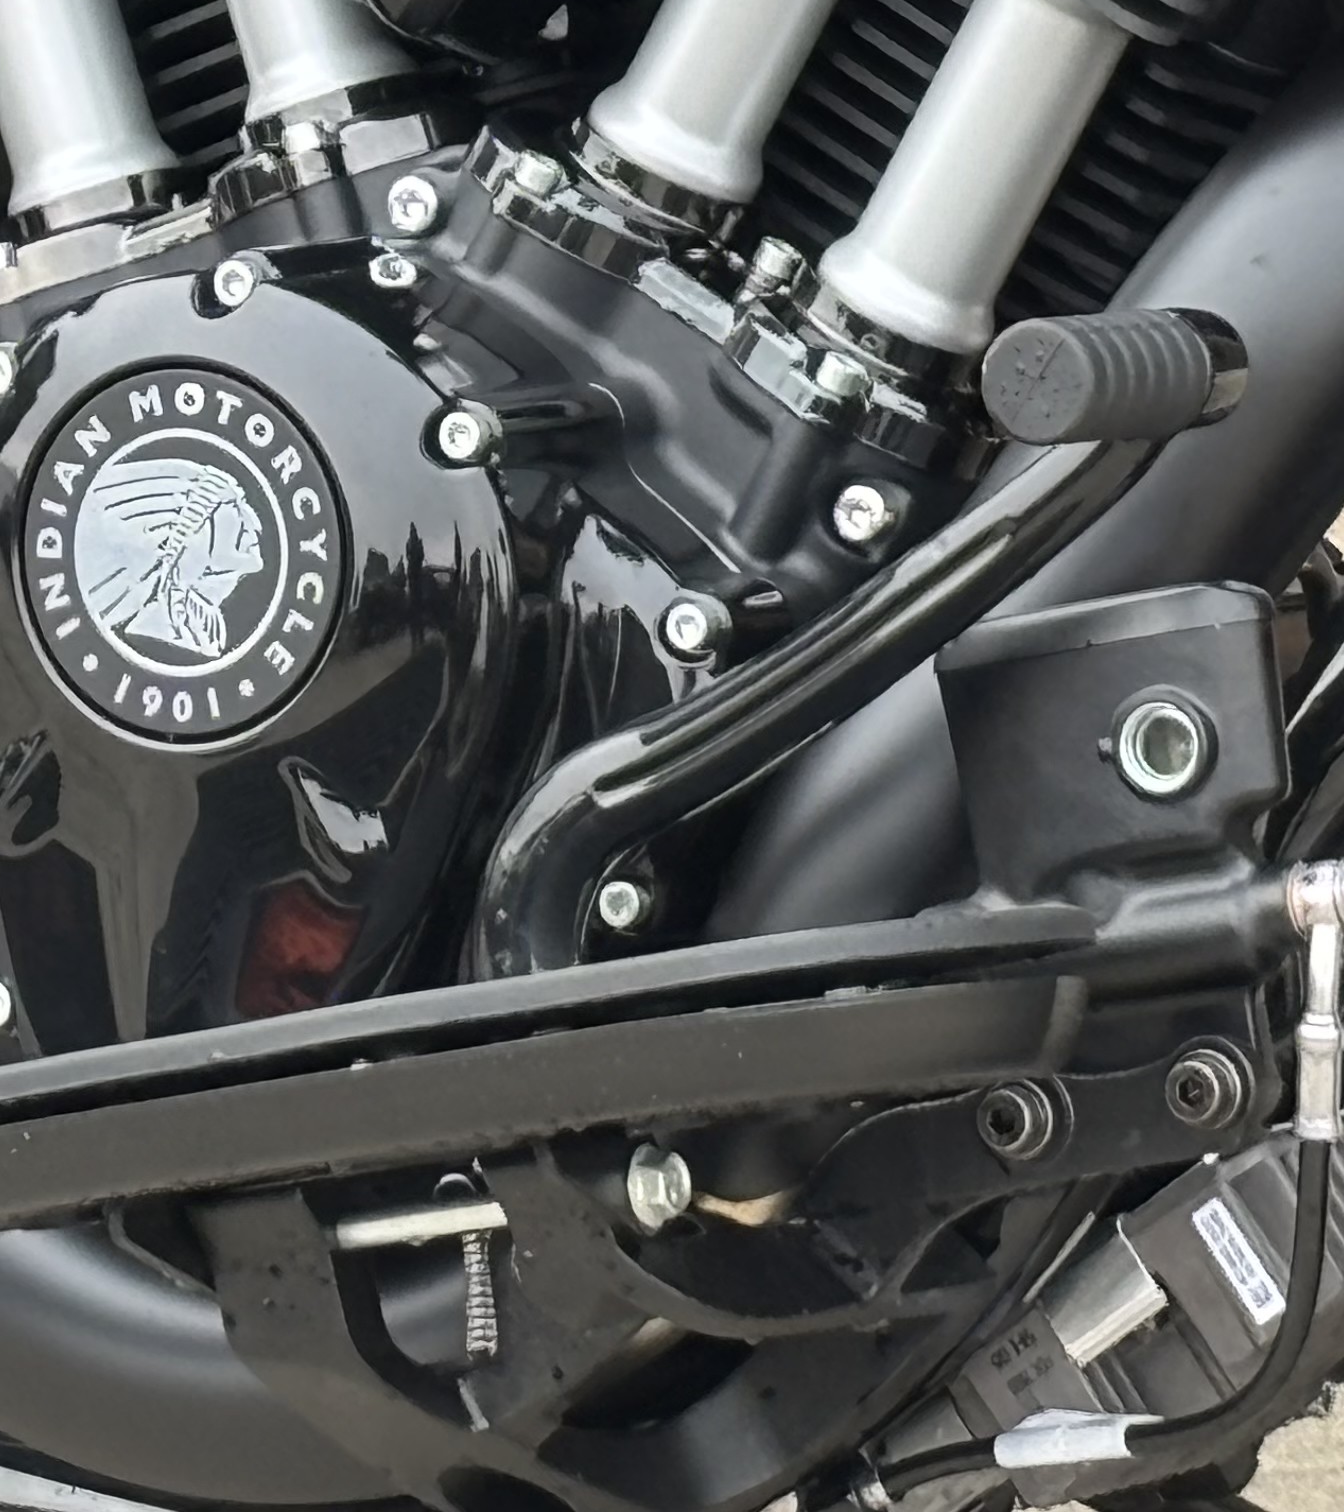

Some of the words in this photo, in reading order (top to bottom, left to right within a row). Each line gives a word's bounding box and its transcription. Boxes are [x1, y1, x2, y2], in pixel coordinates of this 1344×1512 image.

[36, 415, 112, 640] INDIAN
[128, 382, 328, 676] MOTORCYCLE
[114, 673, 220, 722] 1901
